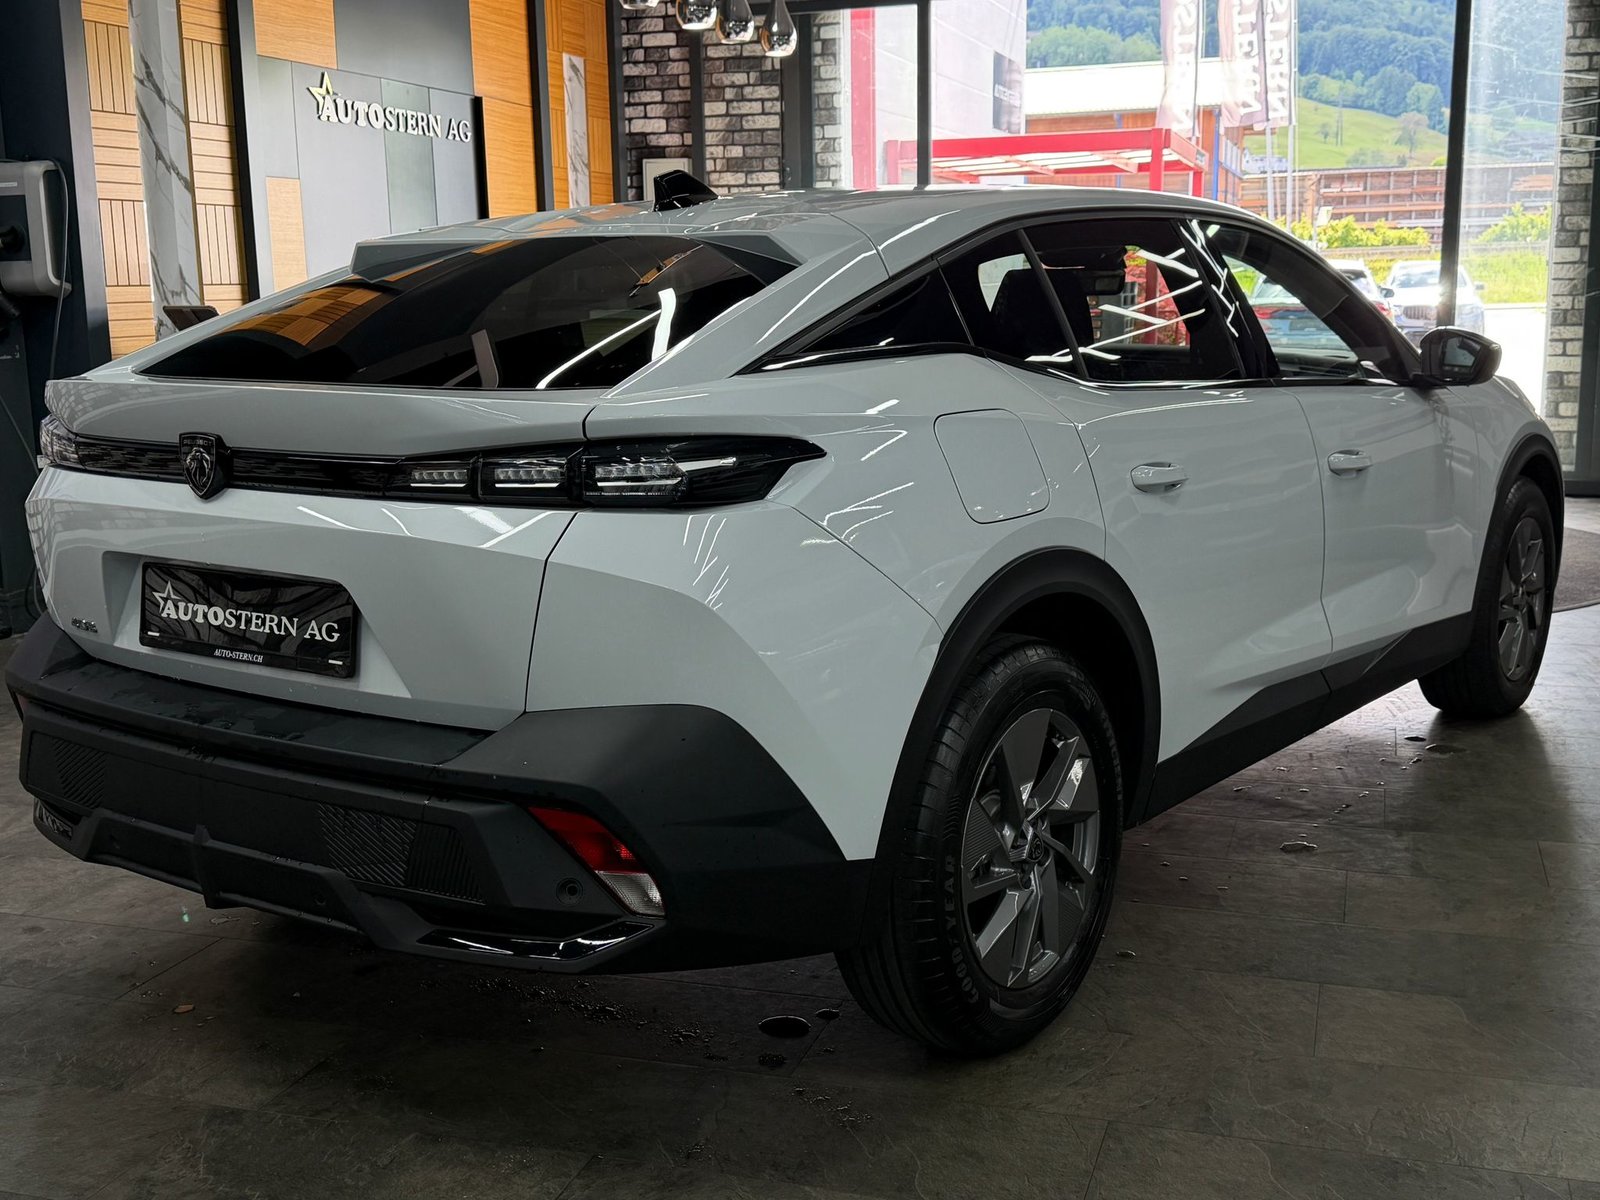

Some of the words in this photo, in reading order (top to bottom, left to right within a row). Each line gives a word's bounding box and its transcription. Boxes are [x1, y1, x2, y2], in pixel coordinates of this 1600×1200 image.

[319, 94, 442, 138] AUTOSTERN
[447, 118, 472, 143] AG
[161, 598, 299, 638] AUTOSTERN
[304, 619, 341, 643] AG
[213, 648, 264, 663] AUTO-STERN.CH
